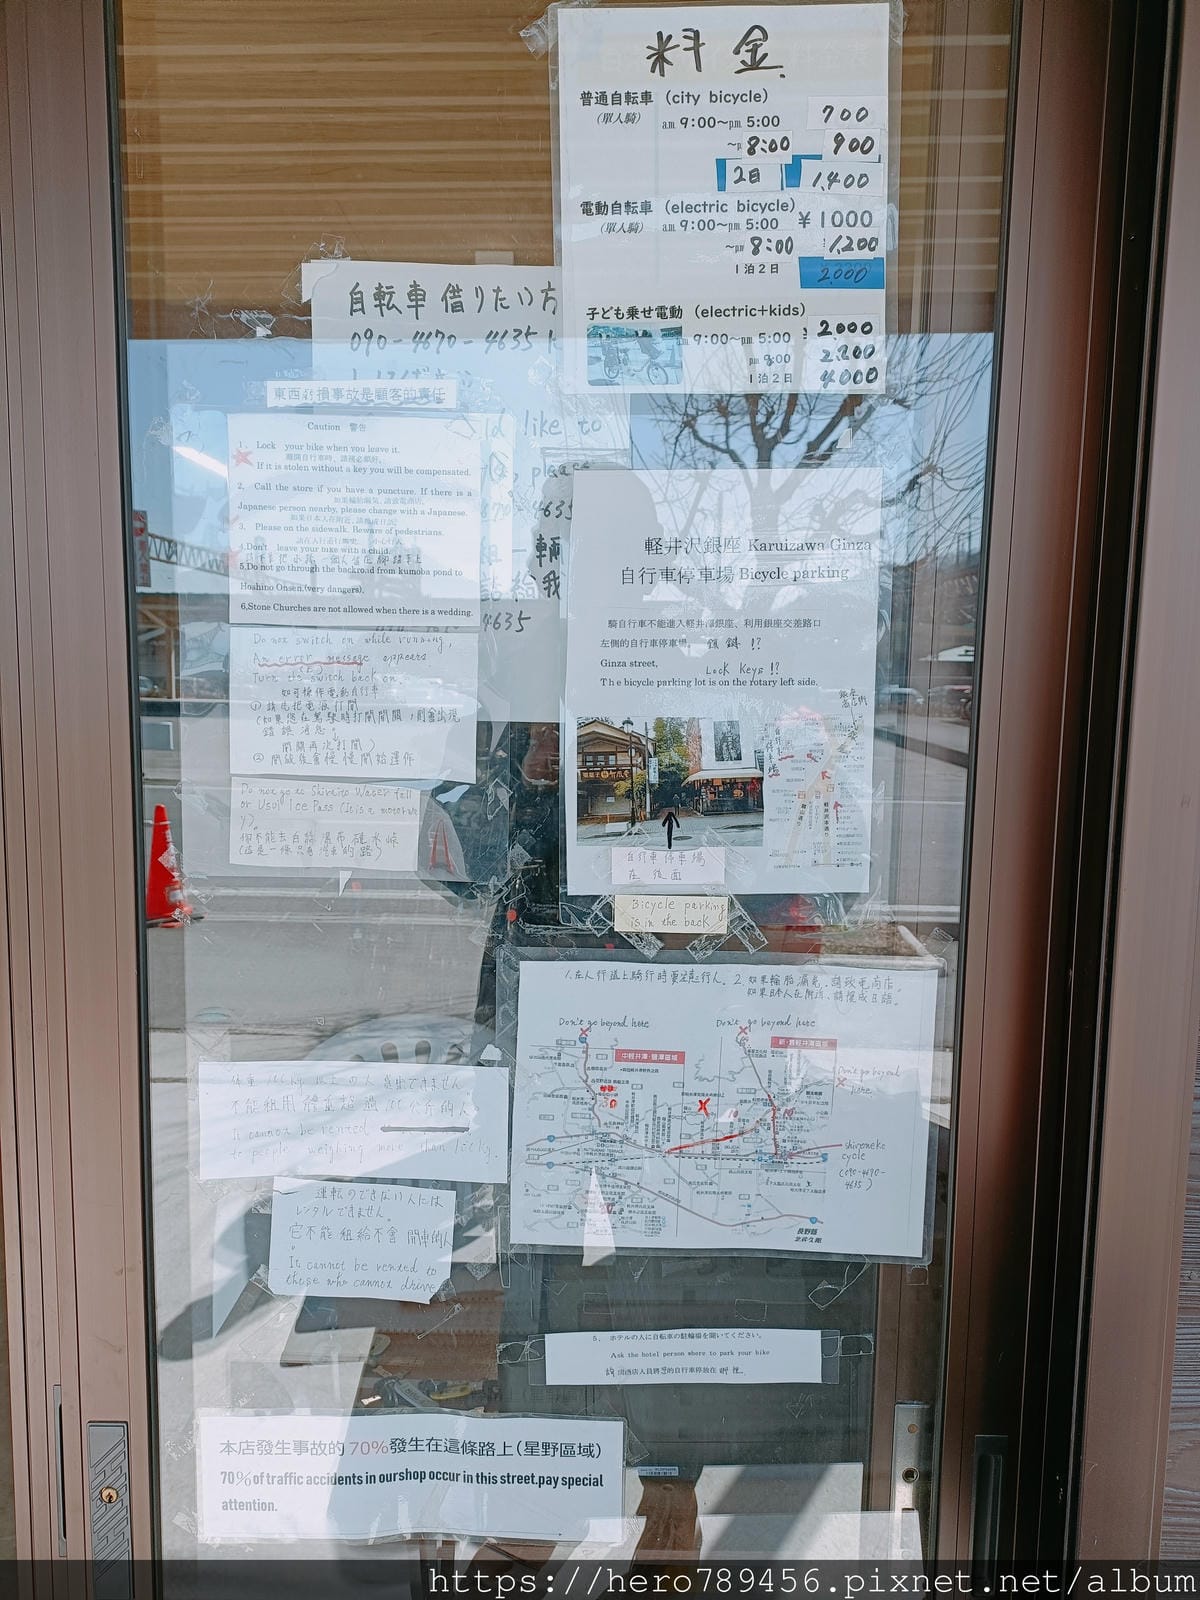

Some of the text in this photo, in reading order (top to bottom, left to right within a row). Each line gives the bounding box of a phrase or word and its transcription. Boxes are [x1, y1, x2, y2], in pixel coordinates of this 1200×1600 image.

[580, 89, 769, 106] 普通自転車 (city bicycle)
[747, 116, 780, 128] 5:00
[822, 106, 869, 123] 700
[833, 132, 874, 154] 900
[580, 199, 796, 216] 電動自転車 (electric bicycle)
[746, 218, 779, 230] 5:00
[750, 236, 794, 255] 8:00
[586, 302, 805, 320] 子ども乗せ電動 (electric+kids)
[758, 332, 791, 344] 5:00
[307, 422, 341, 432] Caution
[256, 441, 276, 450] Lock
[284, 443, 303, 452] your
[306, 442, 324, 452] bike
[326, 443, 348, 452] when
[257, 462, 265, 470] If
[284, 463, 309, 472] stolen
[311, 464, 343, 473] without
[353, 465, 367, 475] key
[370, 467, 384, 476] you
[387, 466, 402, 474] will
[405, 466, 413, 474] be
[254, 482, 271, 491] Call
[275, 483, 288, 492] the
[292, 484, 313, 492] store
[317, 484, 324, 493] if
[327, 486, 342, 495] you
[420, 487, 428, 496] If
[431, 488, 452, 497] there
[644, 535, 872, 556] 軽井沢銀座 Karuizawa Ginza
[621, 566, 848, 585] 自行車停車場 Bicycle parking
[273, 603, 473, 618] Churches are not allowed when there is wedding.
[600, 659, 658, 669] Ginza street,
[600, 677, 622, 687] The
[624, 677, 654, 687] bicycle
[657, 678, 691, 689] parking
[694, 678, 706, 687] lot
[709, 678, 716, 687] is
[732, 678, 747, 687] the
[749, 678, 777, 689] rotary
[780, 677, 794, 687] left
[797, 678, 818, 687] side.
[720, 1350, 734, 1358] park
[266, 1471, 303, 1486] traffic
[306, 1471, 363, 1487] accidents
[366, 1471, 376, 1485] in
[429, 1470, 461, 1483] occur
[463, 1470, 473, 1484] in
[476, 1470, 498, 1485] this
[562, 1473, 604, 1489] special
[221, 1498, 278, 1513] attention.
